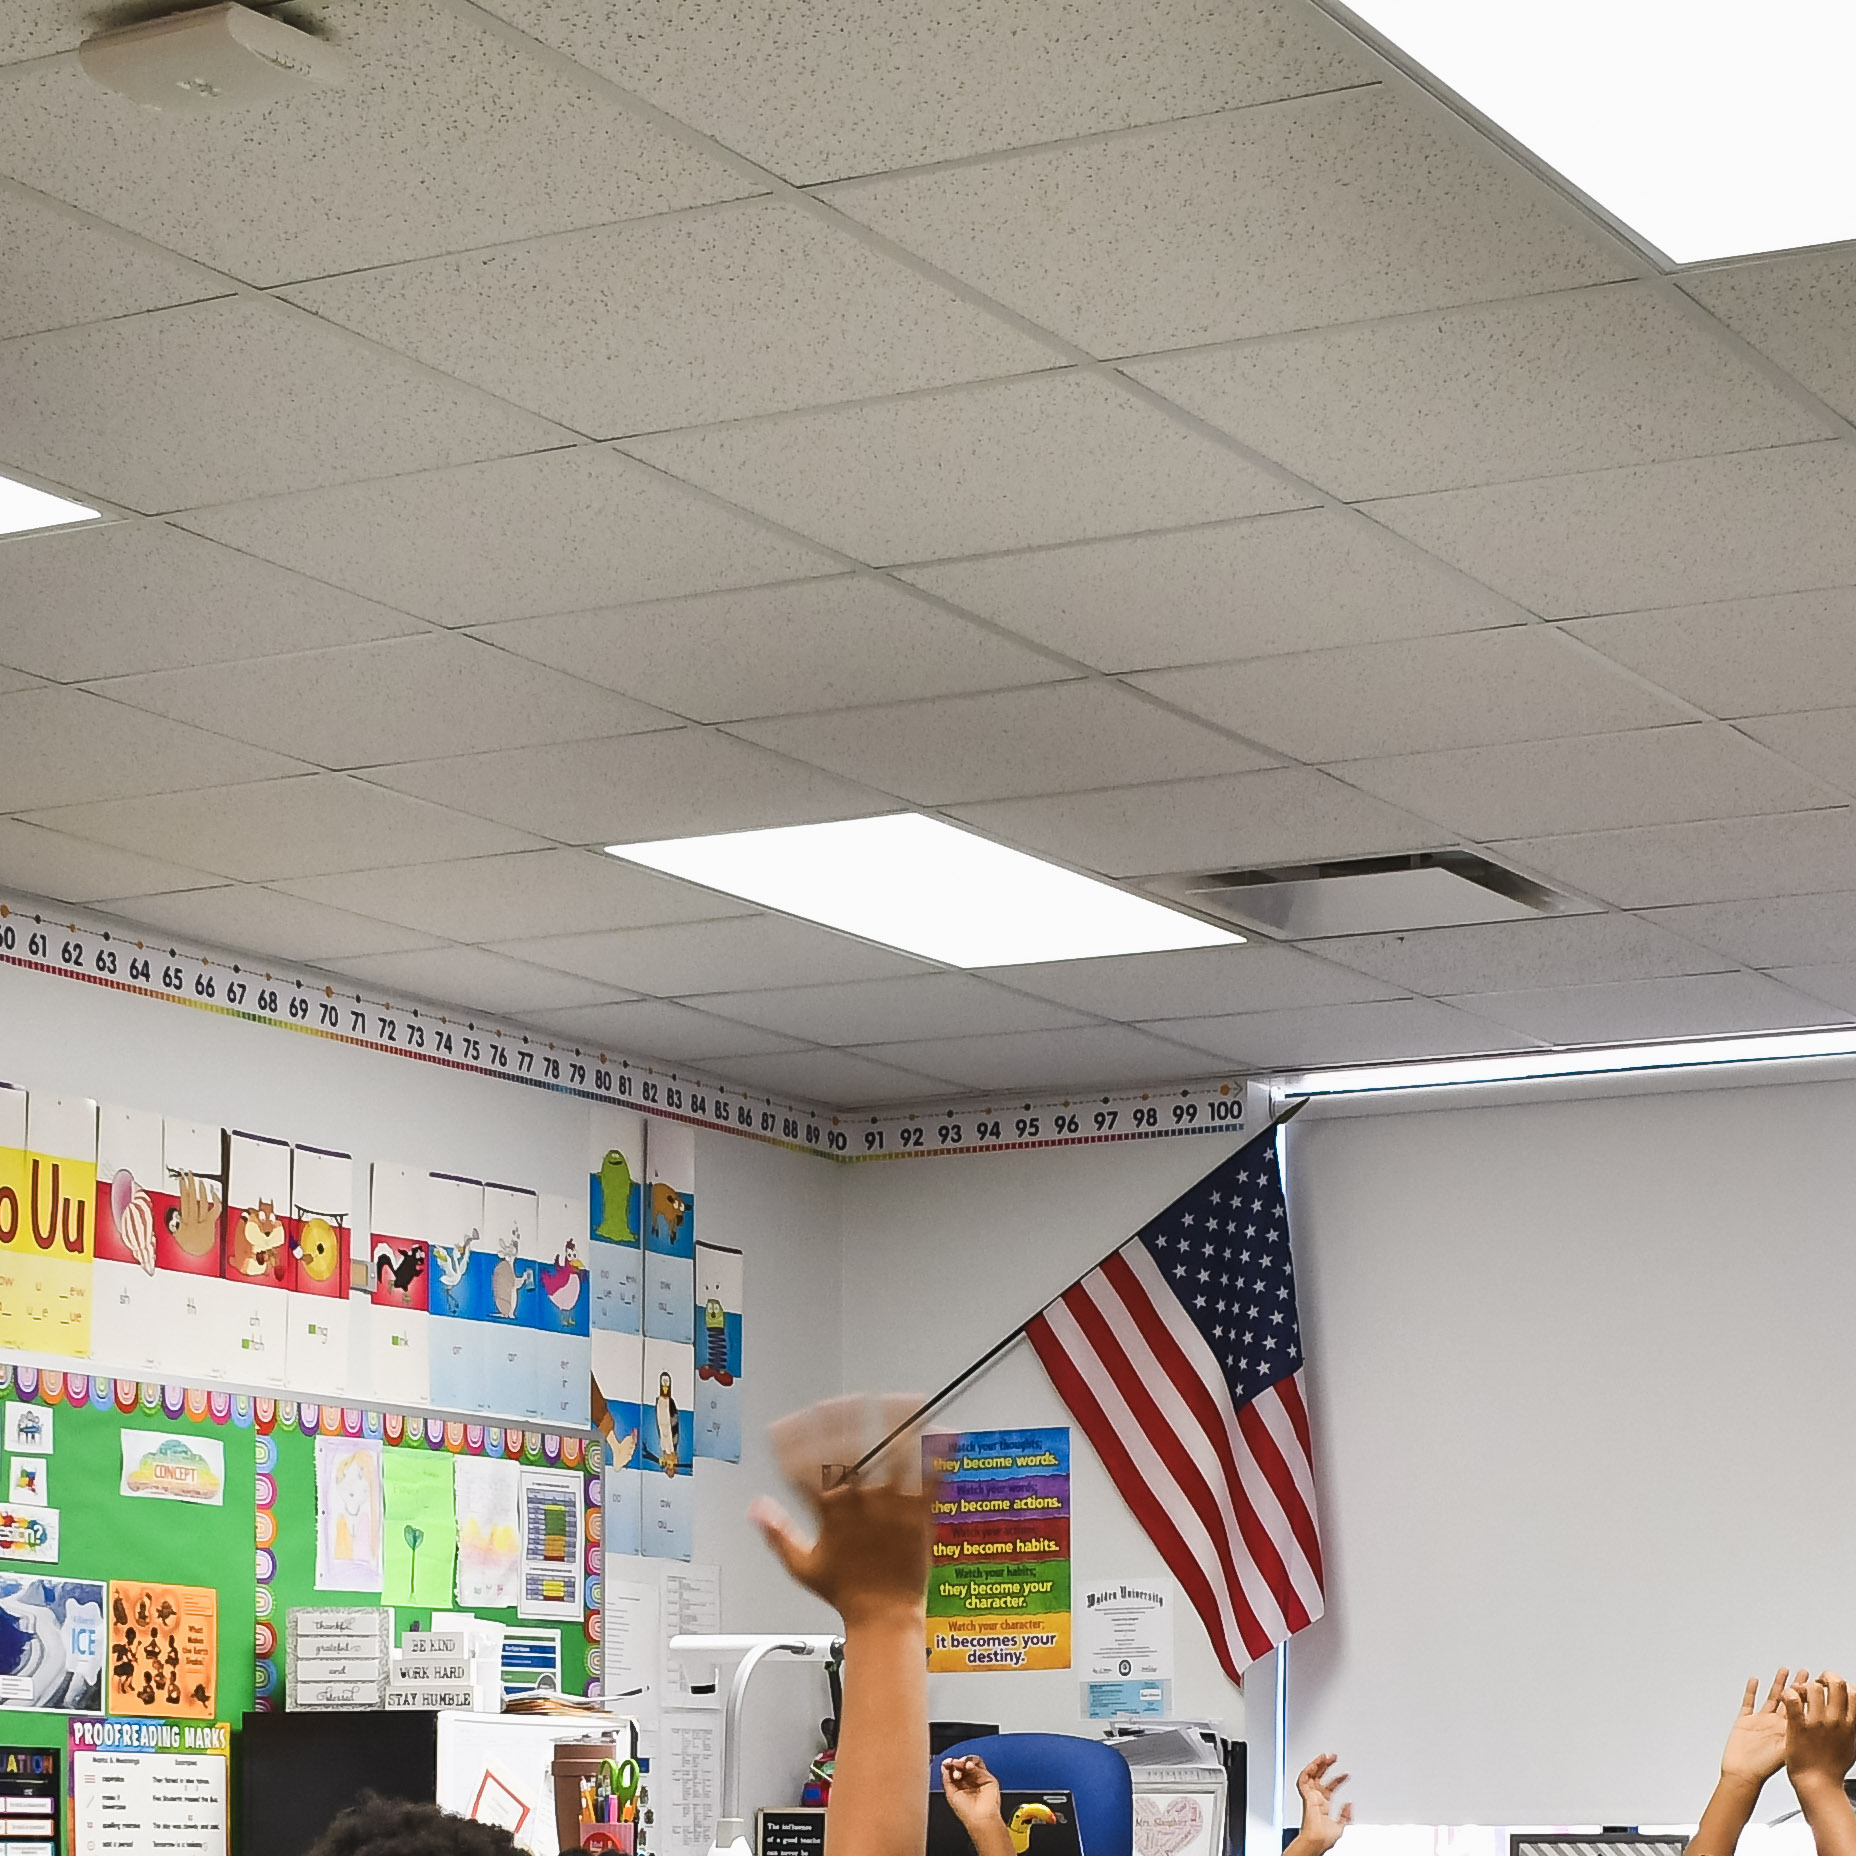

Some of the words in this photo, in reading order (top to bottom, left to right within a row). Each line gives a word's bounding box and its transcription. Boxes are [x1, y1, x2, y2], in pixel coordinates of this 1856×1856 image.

[28, 932, 47, 959] 61
[162, 965, 183, 991] 65
[289, 996, 309, 1020] 69
[406, 1023, 425, 1048] 73
[517, 1050, 535, 1073] 77
[618, 1074, 632, 1097] 81
[714, 1099, 730, 1122] 85
[805, 1123, 821, 1145] 89
[937, 1123, 963, 1145] 93
[1093, 1110, 1119, 1132] 97
[1207, 1099, 1243, 1122] 100
[30, 1158, 85, 1254] Uu
[964, 1456, 1012, 1468] become
[1016, 1452, 1058, 1466] words.
[155, 1464, 196, 1482] CONCEPT
[961, 1499, 1011, 1511] become
[1014, 1495, 1061, 1509] actions.
[933, 1544, 960, 1558] they
[964, 1541, 1013, 1554] become
[1017, 1538, 1059, 1551] habits.
[955, 1568, 983, 1578] Watch
[985, 1568, 1004, 1580] your
[940, 1583, 967, 1597] they
[971, 1582, 1020, 1595] become
[1024, 1582, 1053, 1596] your
[1120, 1586, 1164, 1606] University
[966, 1596, 1026, 1608] character.
[949, 1621, 976, 1632] Watch
[979, 1622, 997, 1633] your
[72, 1629, 95, 1656] ICE
[411, 1639, 427, 1653] BE
[430, 1639, 456, 1653] KIND
[936, 1635, 946, 1648] it
[951, 1634, 1017, 1648] becomes
[1022, 1634, 1056, 1649] your
[968, 1649, 1025, 1665] destiny.
[400, 1666, 430, 1680] WORK
[434, 1666, 465, 1680] HARD
[387, 1692, 418, 1706] STAY
[422, 1693, 471, 1707] HUMBLE
[73, 1722, 180, 1748] PROOFREADING
[184, 1726, 226, 1749] MARKS
